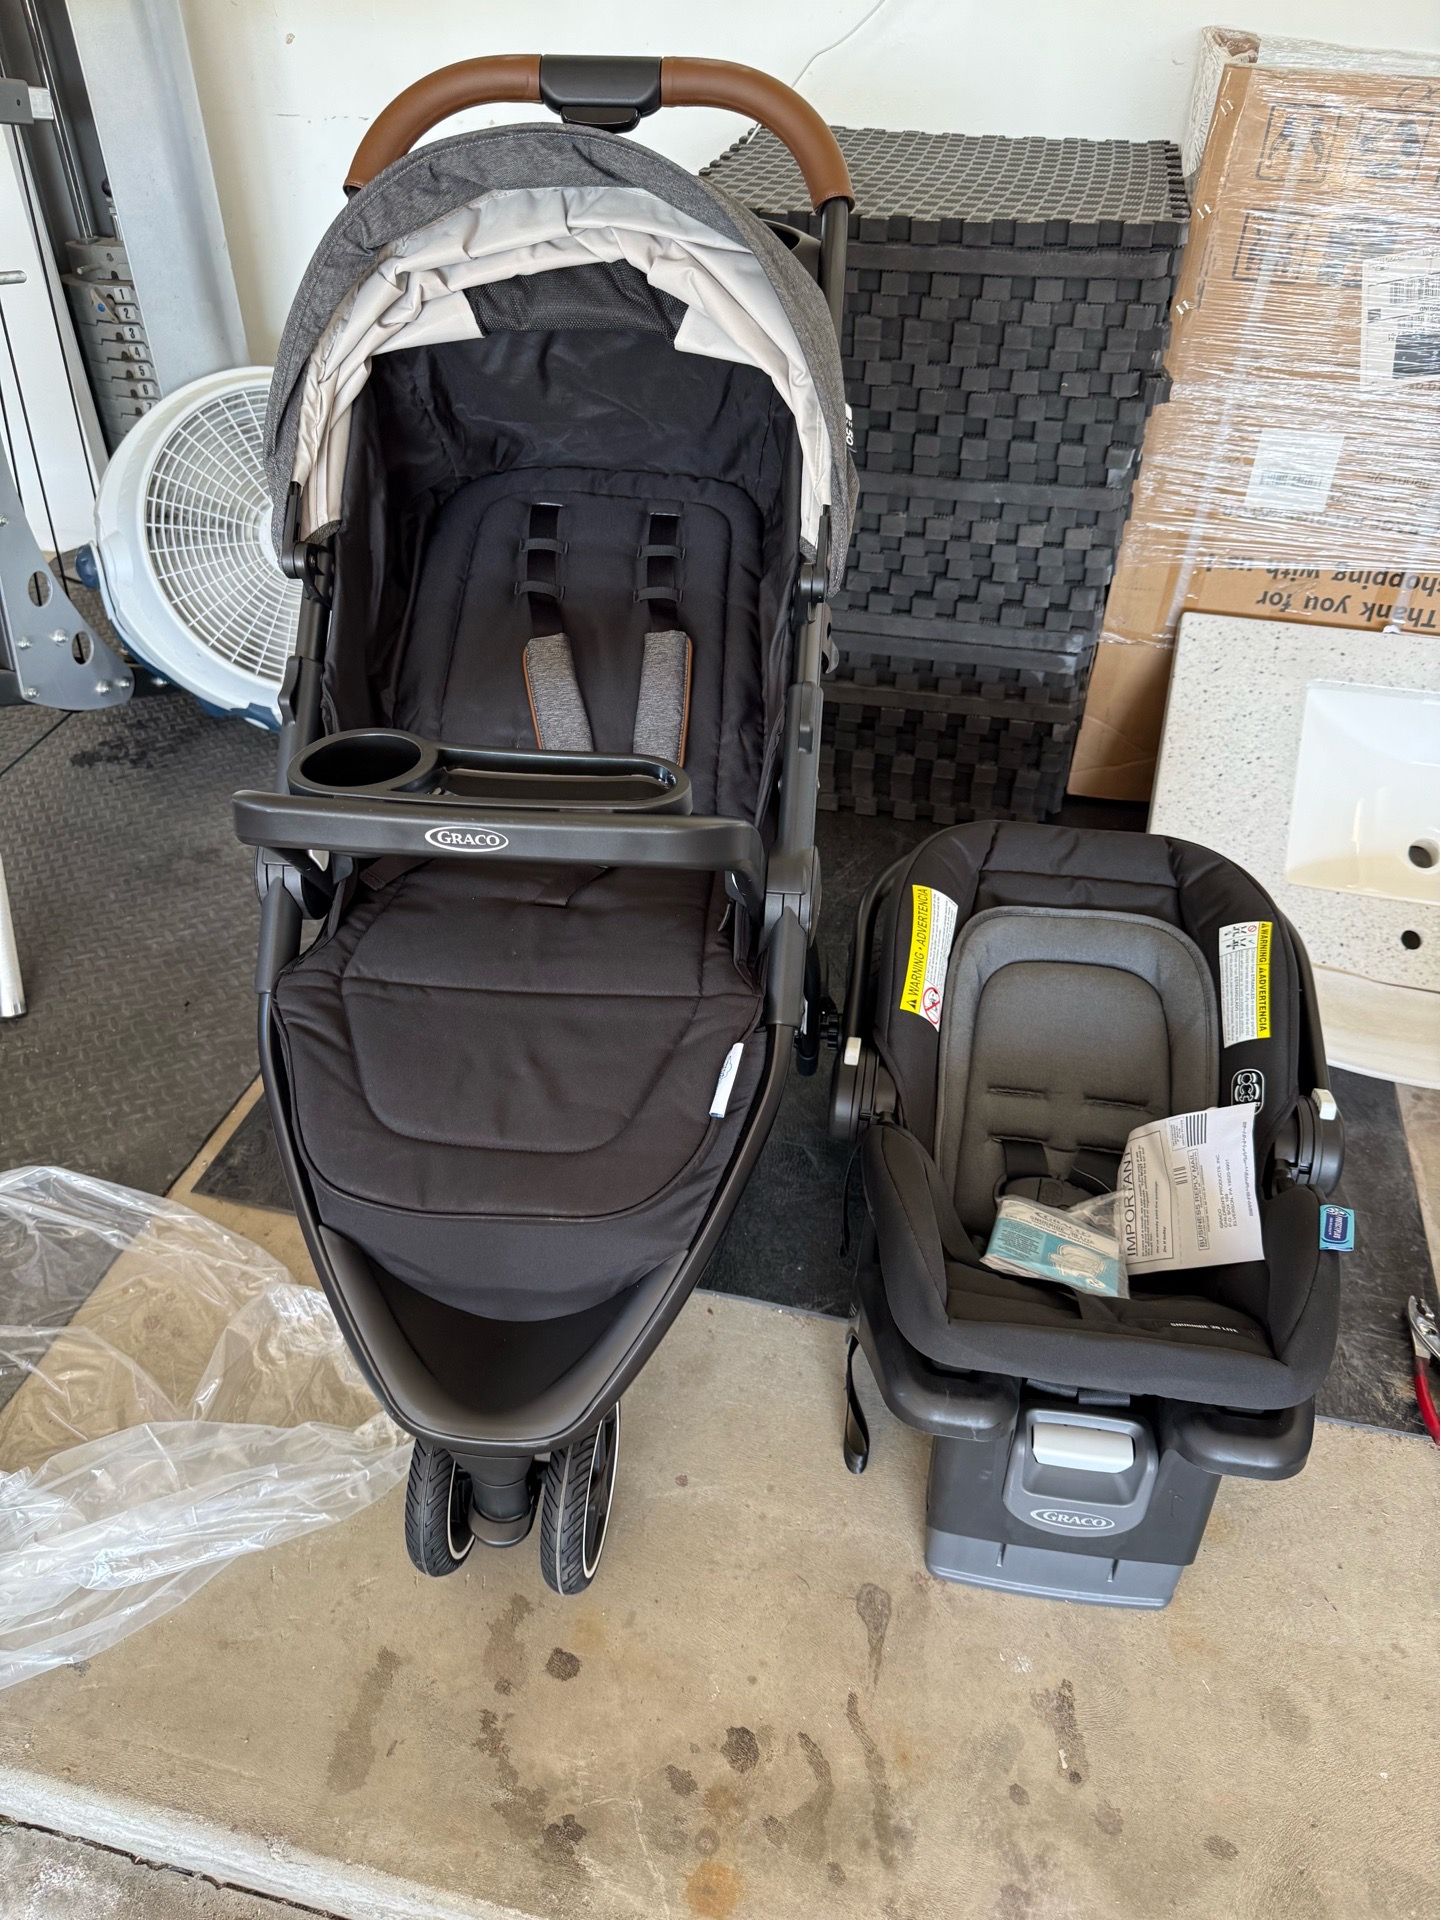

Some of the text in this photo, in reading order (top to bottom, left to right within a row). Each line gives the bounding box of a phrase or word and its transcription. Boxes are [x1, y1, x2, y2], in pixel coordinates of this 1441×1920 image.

[119, 289, 125, 300] 1
[124, 308, 130, 319] 2
[129, 328, 136, 339] 3
[134, 346, 141, 358] 4
[138, 365, 145, 376] 5
[1256, 591, 1436, 628] Thank you for
[437, 830, 500, 846] GRACO
[908, 888, 928, 996] WARNING ADVERTENCIA
[1258, 928, 1268, 1032] WARNING ADVERTENCIA
[1195, 1203, 1204, 1246] BUSINESS
[1043, 1512, 1106, 1526] GRACO
